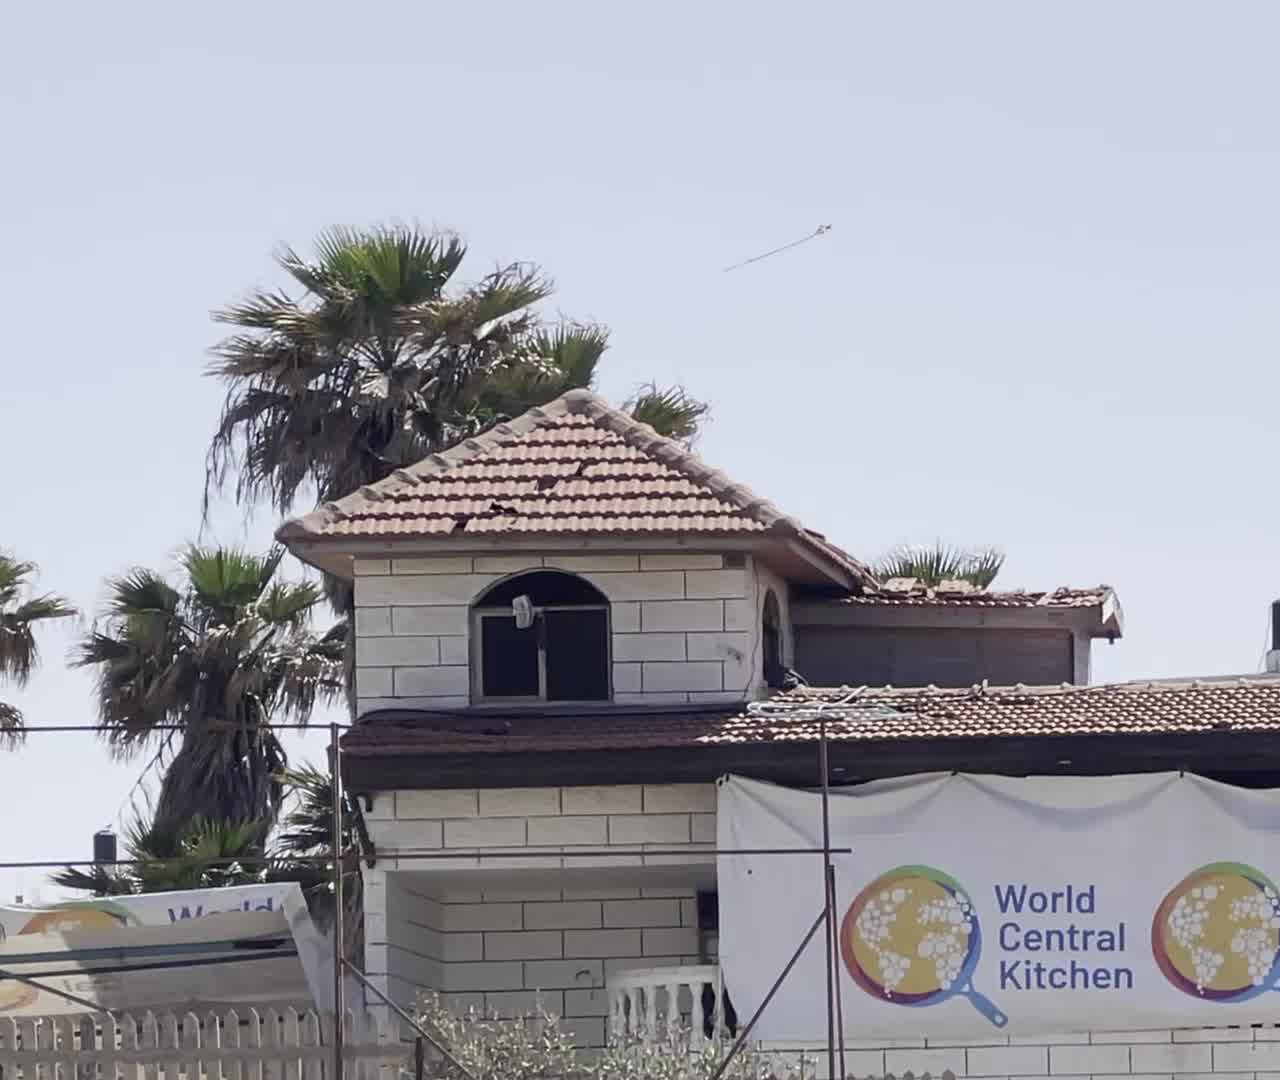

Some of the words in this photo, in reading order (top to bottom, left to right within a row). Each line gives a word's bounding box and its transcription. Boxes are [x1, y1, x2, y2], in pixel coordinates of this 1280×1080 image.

[994, 884, 1096, 914] World
[999, 922, 1126, 953] Central
[999, 959, 1134, 990] Kitchen
